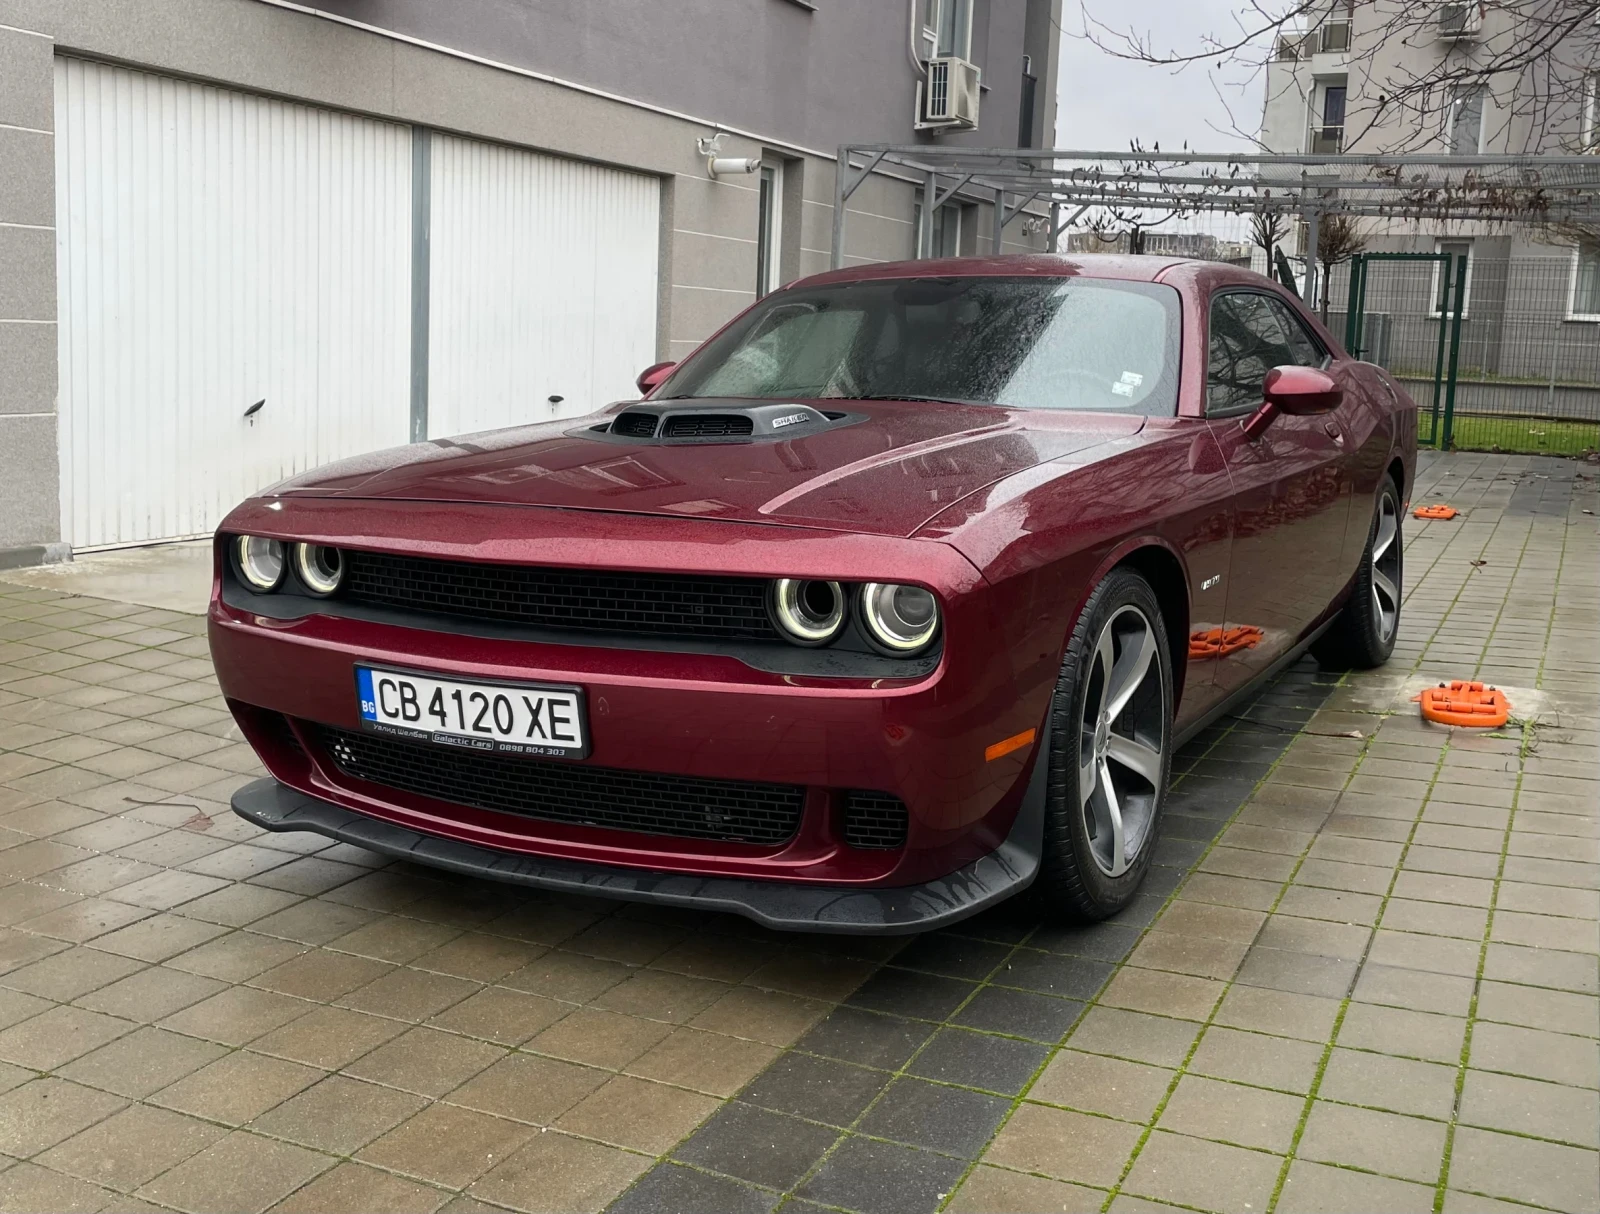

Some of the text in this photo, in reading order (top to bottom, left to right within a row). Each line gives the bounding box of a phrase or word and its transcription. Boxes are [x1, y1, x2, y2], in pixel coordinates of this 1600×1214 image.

[772, 412, 809, 428] SHAKER
[361, 700, 375, 713] BG
[378, 678, 576, 742] CB 4120 XE
[373, 723, 397, 735] Уалид
[434, 733, 492, 748] Galactic Cars
[499, 743, 566, 756] 0898 804 303
